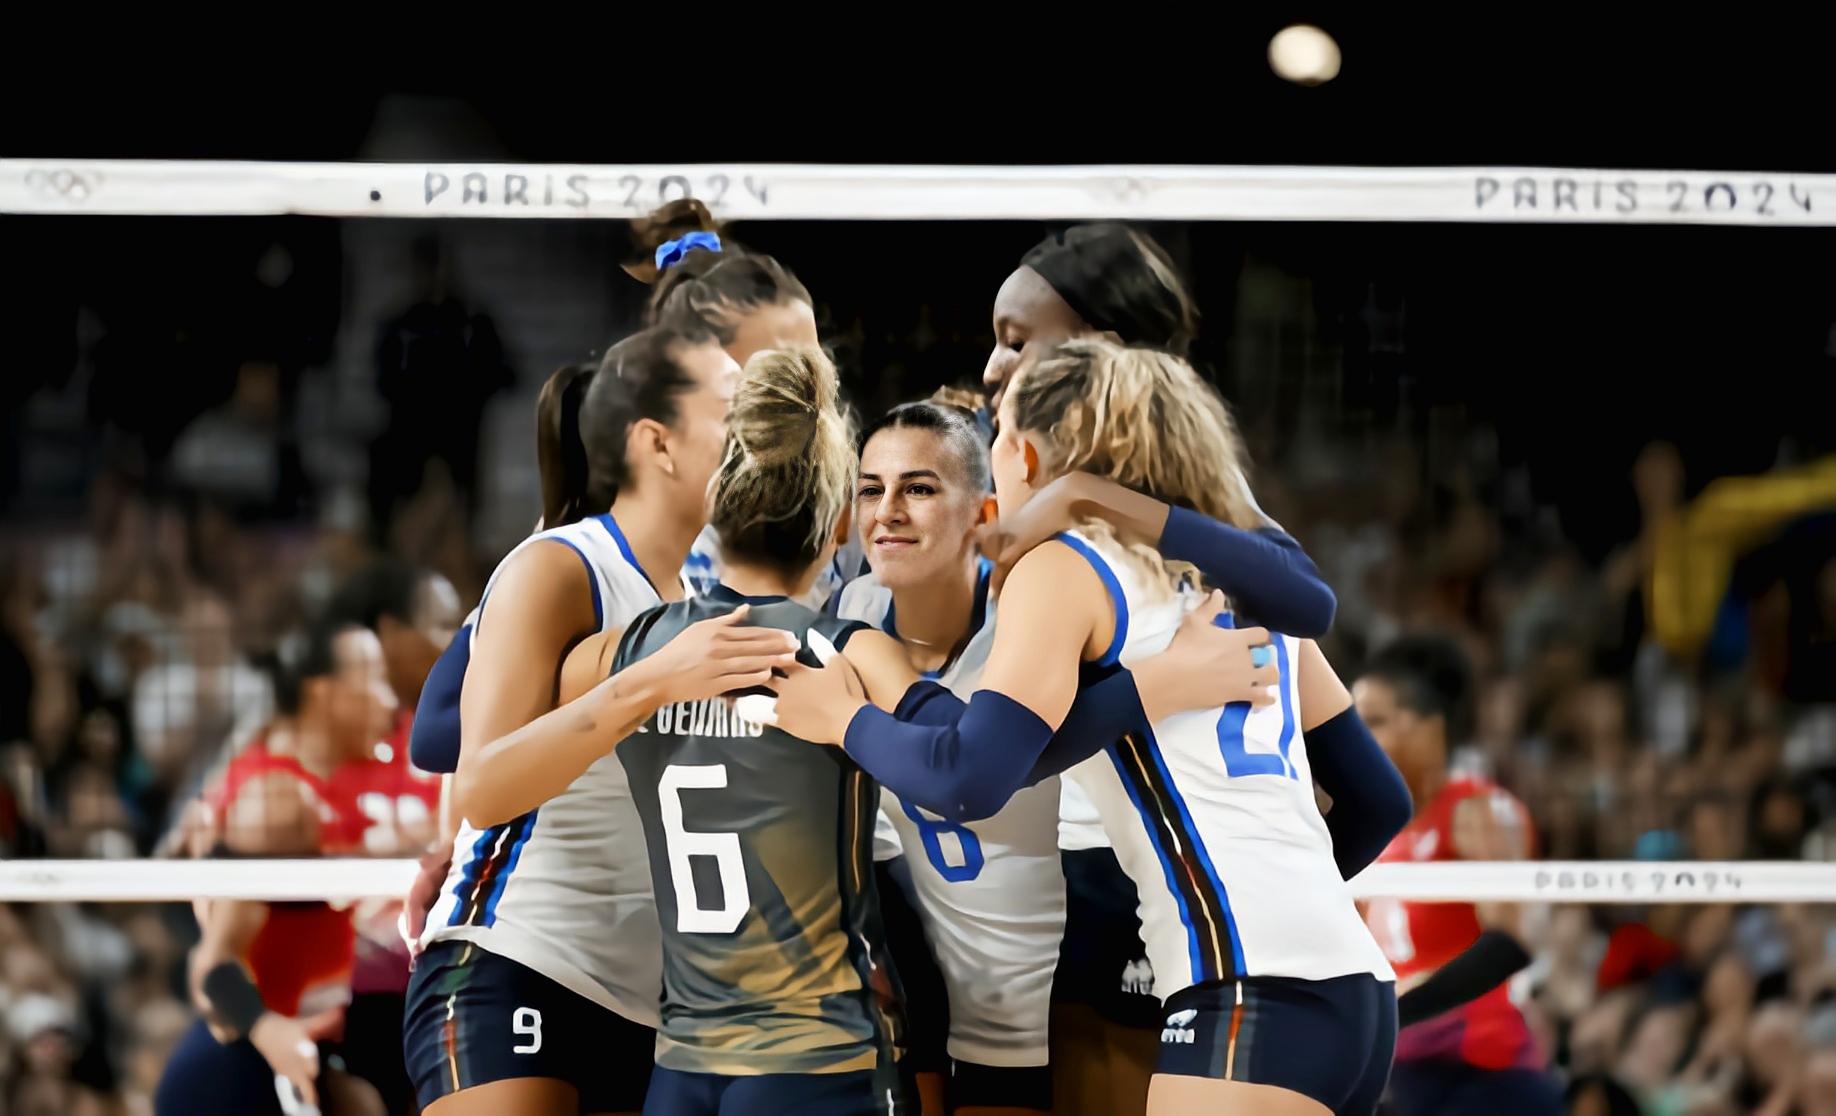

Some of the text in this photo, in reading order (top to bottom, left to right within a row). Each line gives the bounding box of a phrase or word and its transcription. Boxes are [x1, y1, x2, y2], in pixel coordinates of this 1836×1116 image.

[424, 171, 768, 209] PARIS 2024
[1474, 177, 1811, 215] PARIS 2024
[658, 764, 750, 933] 6
[513, 1007, 542, 1054] 9
